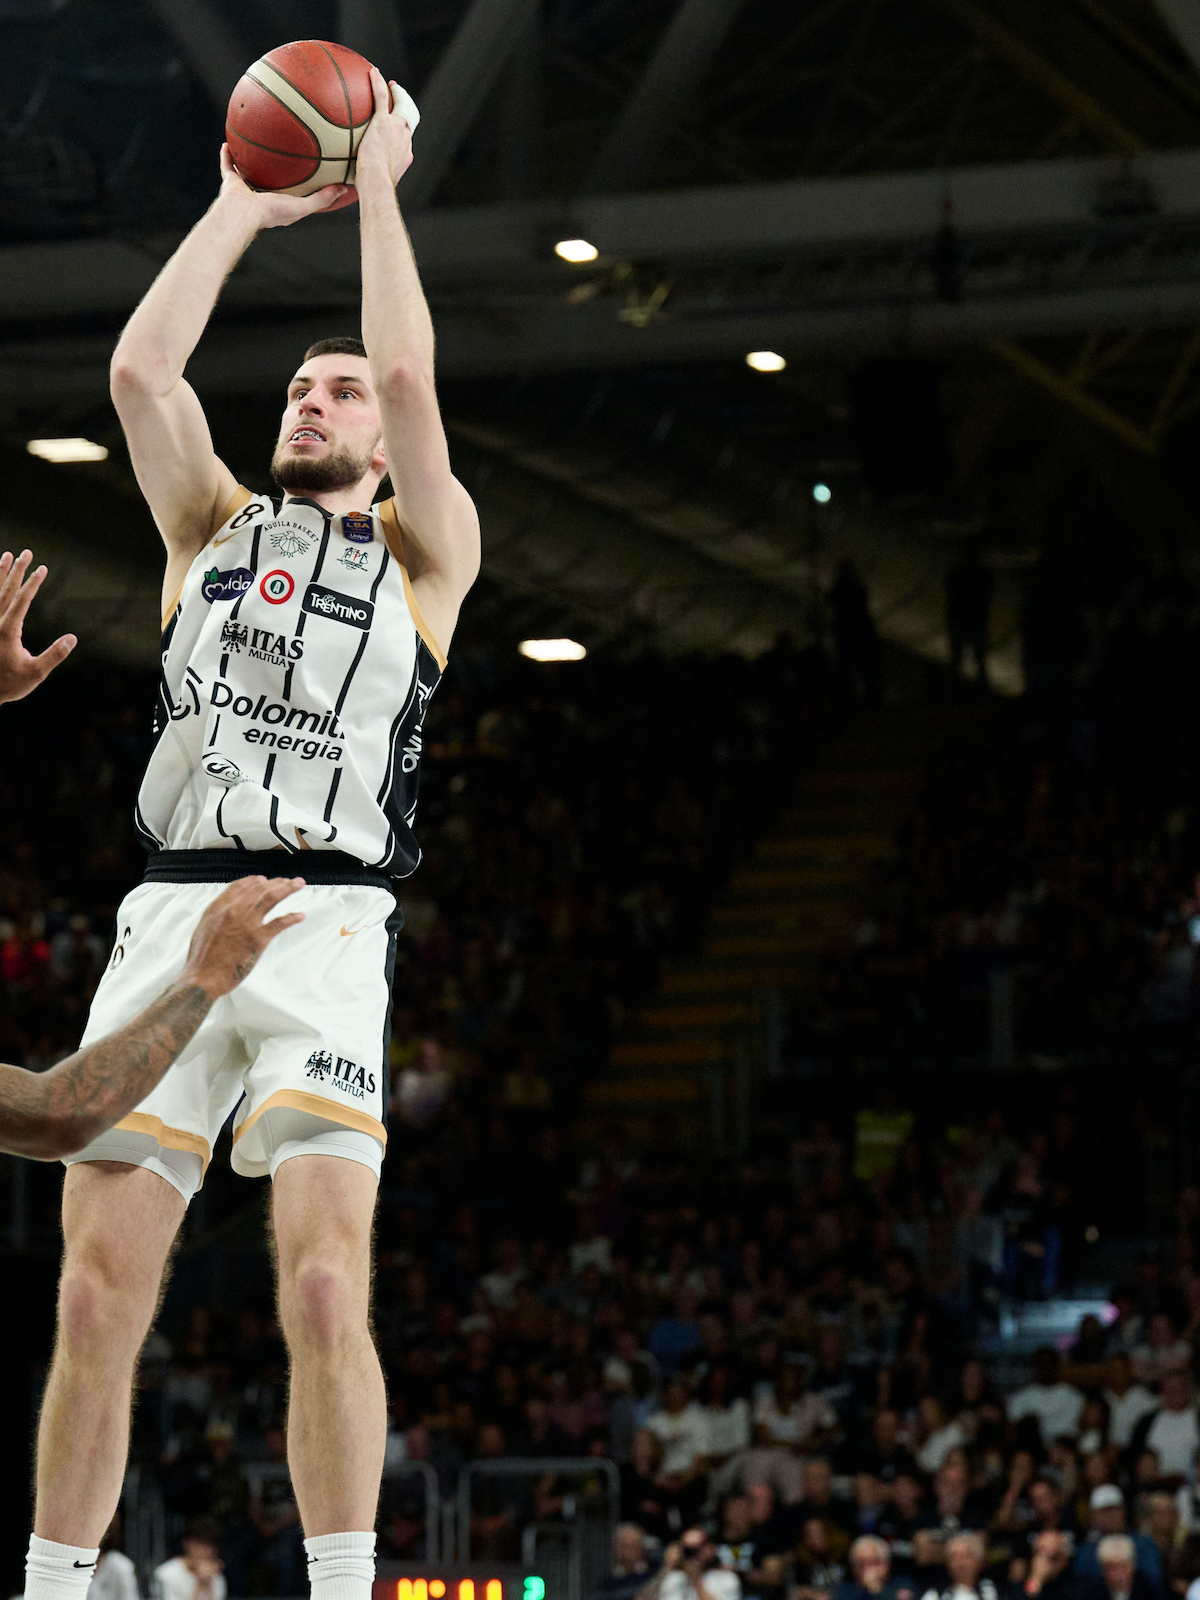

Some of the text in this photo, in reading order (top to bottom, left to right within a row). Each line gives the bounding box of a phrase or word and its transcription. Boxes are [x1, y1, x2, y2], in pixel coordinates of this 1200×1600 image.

[230, 503, 264, 529] 8
[263, 520, 319, 543] AQUILA BASKET
[310, 592, 368, 622] TRENTINO
[248, 648, 288, 668] MUTUA
[250, 627, 305, 660] ITAS
[210, 681, 345, 740] Dolomit
[242, 728, 343, 761] energia
[331, 1077, 365, 1101] MUTUA
[333, 1056, 376, 1094] ITAS
